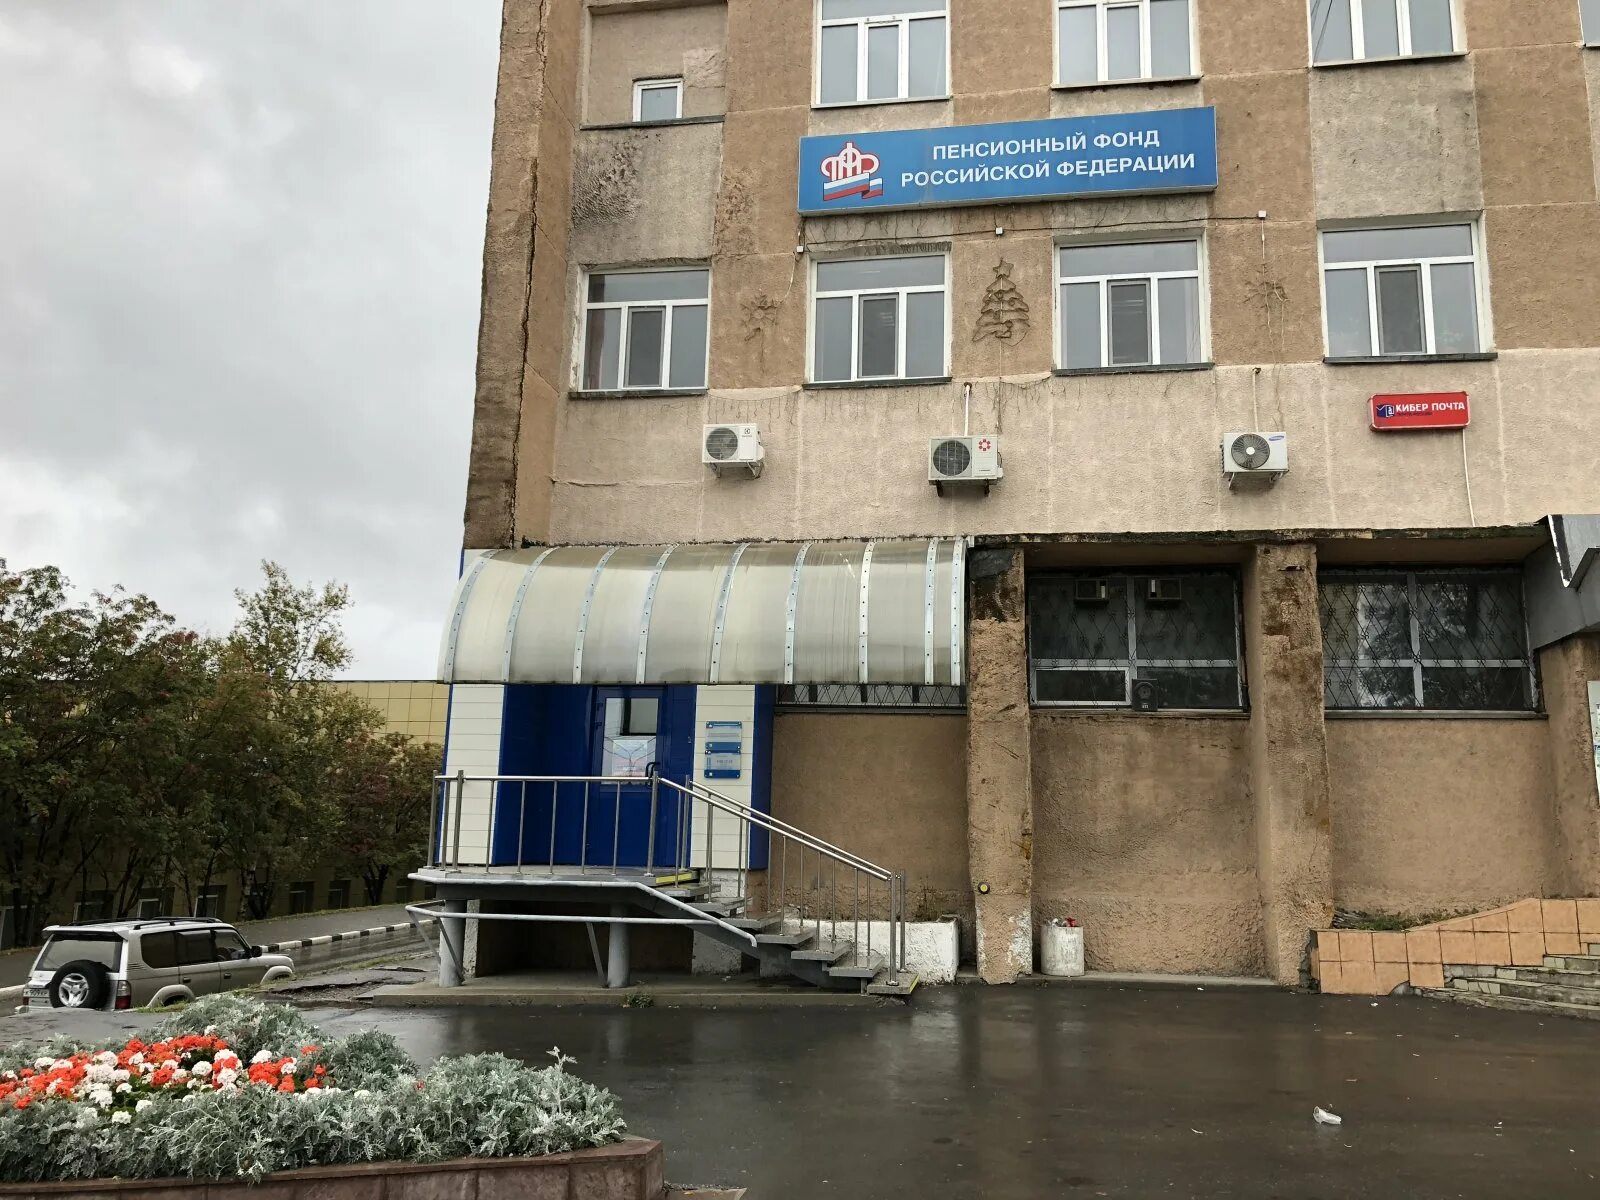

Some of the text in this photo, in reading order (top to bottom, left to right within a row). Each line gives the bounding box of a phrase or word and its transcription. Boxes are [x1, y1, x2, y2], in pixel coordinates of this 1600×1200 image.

[932, 130, 1161, 162] ПЕНСИОННЫЙ ФОНД
[900, 153, 1196, 188] РОССИЙСКОЙ ФЕДЕРАЦИИ
[1395, 402, 1466, 412] КИБЕР ПОЧТА
